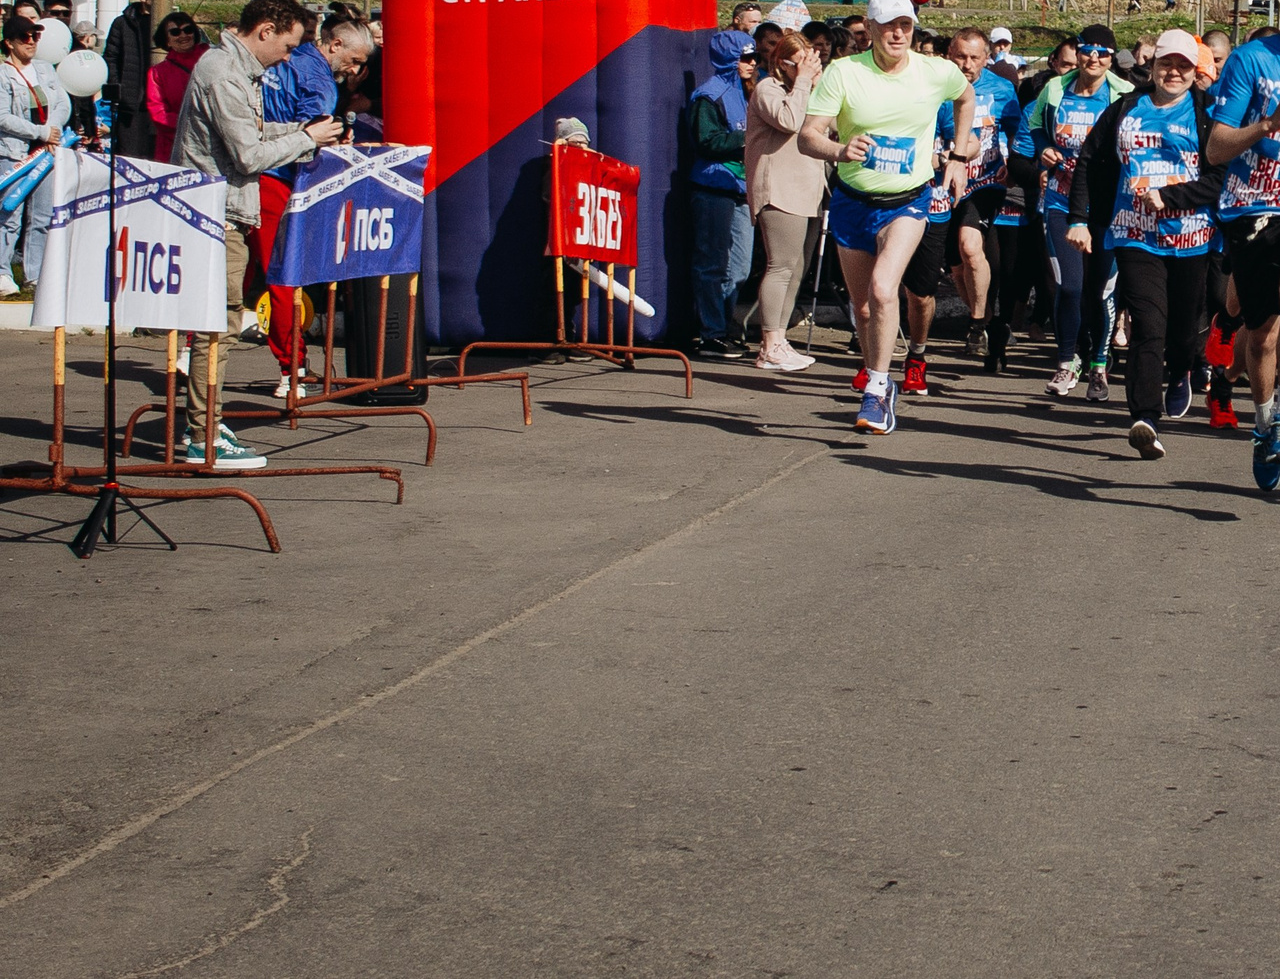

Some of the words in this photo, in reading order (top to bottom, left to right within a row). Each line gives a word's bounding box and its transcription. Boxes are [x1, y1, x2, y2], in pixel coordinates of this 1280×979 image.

[873, 146, 908, 162] 40001
[354, 207, 394, 251] ПСБ
[132, 240, 183, 295] ПСБ
